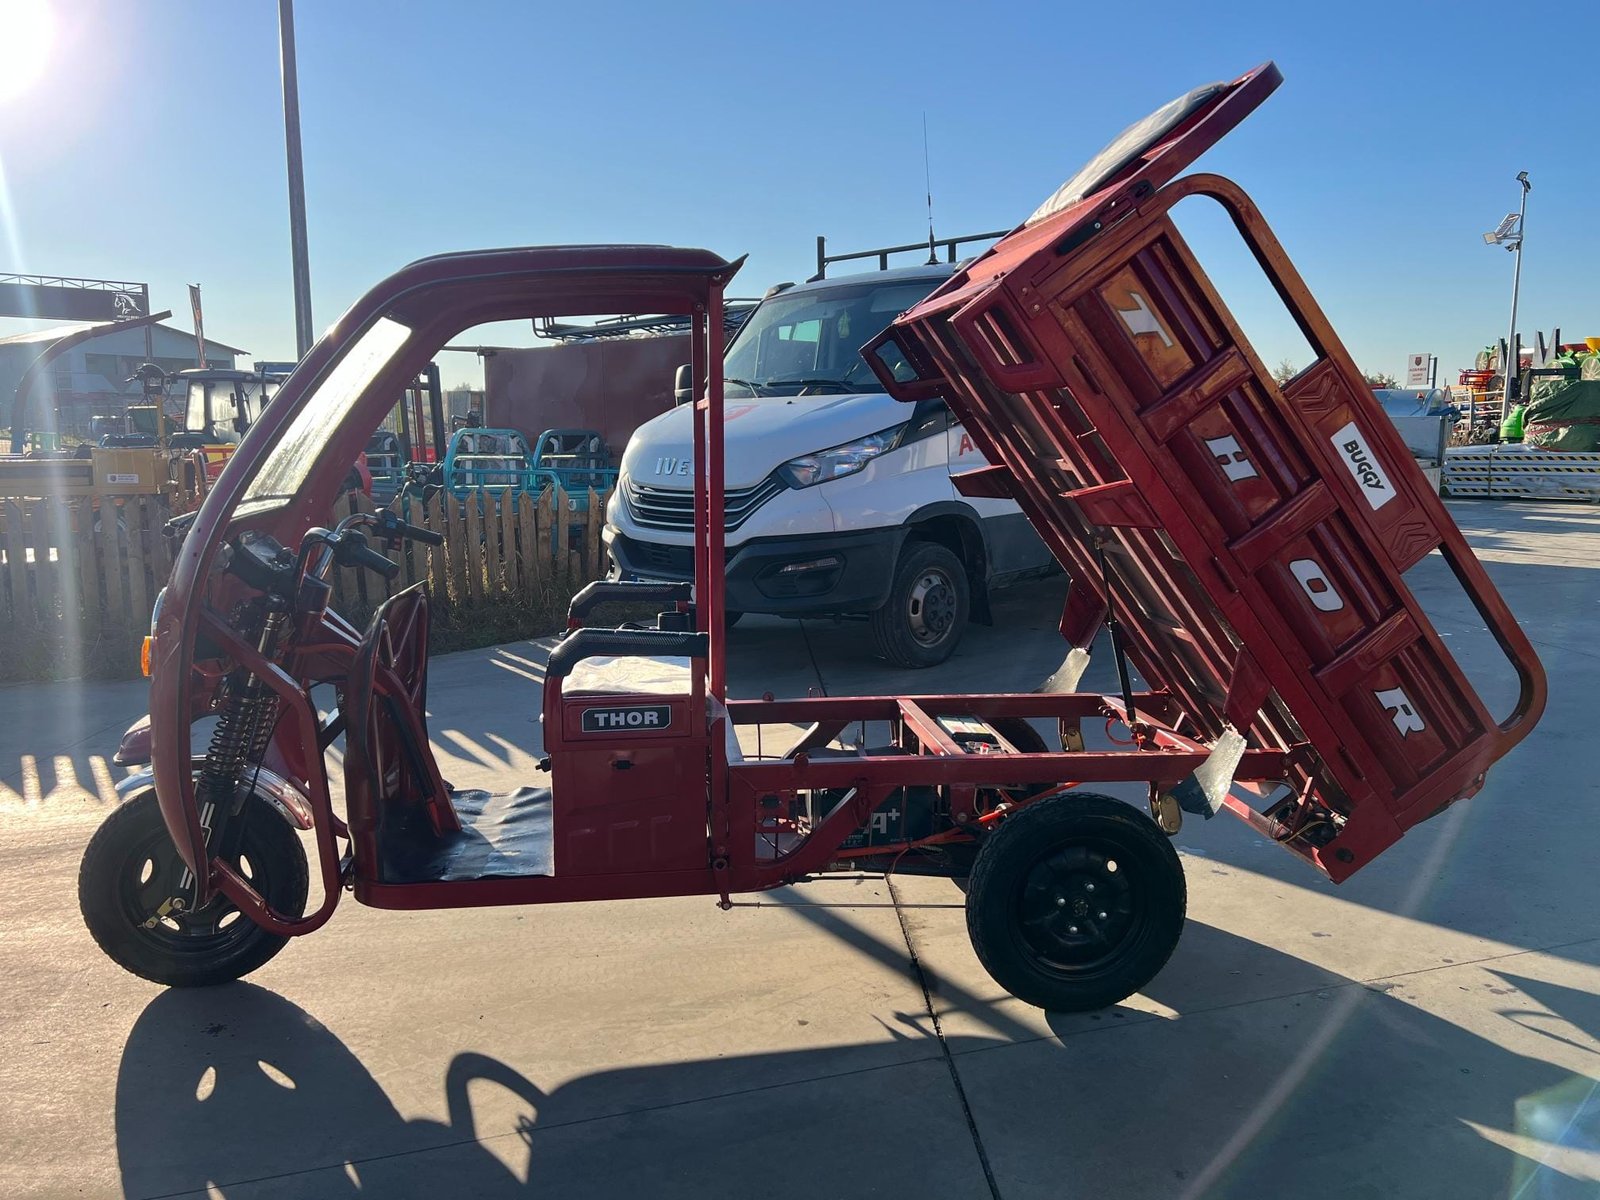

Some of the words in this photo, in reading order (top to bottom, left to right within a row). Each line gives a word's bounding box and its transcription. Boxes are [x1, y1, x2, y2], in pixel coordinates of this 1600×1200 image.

[655, 457, 708, 476] IVE
[1343, 439, 1386, 490] BUGGY
[1117, 292, 1426, 739] THOR
[594, 711, 659, 727] THOR
